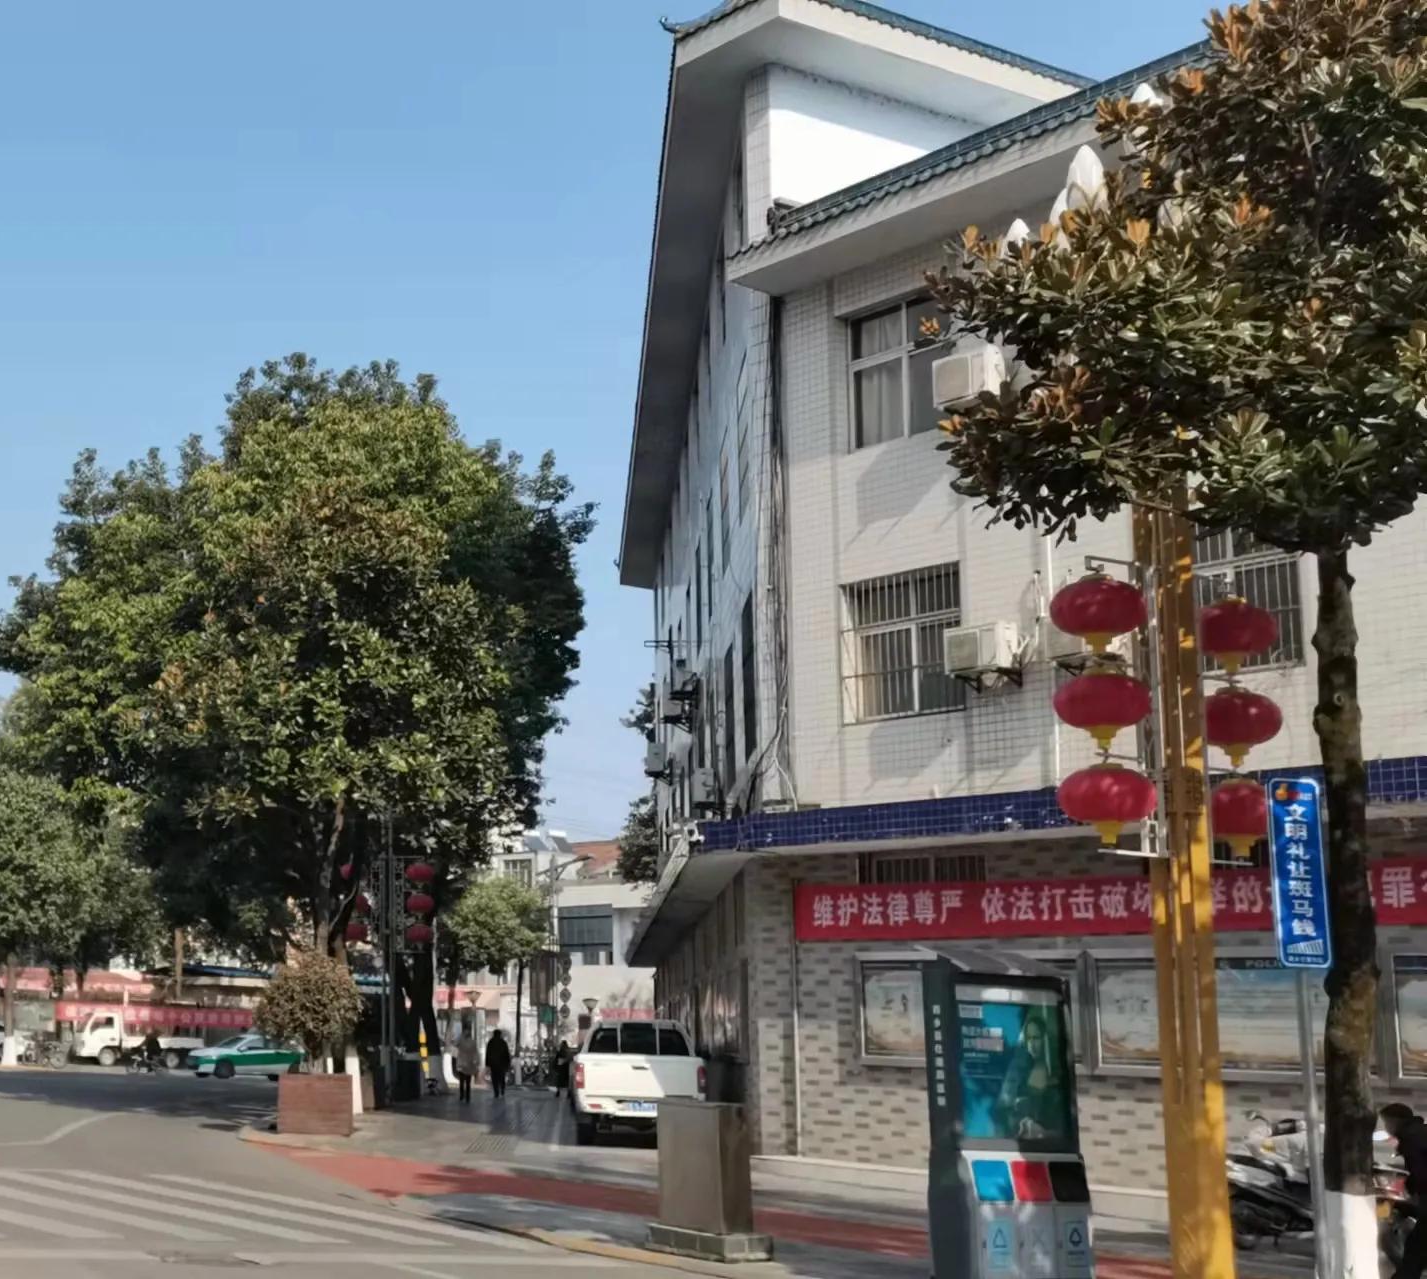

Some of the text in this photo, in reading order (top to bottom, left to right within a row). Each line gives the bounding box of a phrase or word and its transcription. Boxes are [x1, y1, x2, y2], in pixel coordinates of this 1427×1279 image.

[811, 889, 964, 927] 维护法律尊严
[1283, 803, 1317, 936] 文明礼让斑马线
